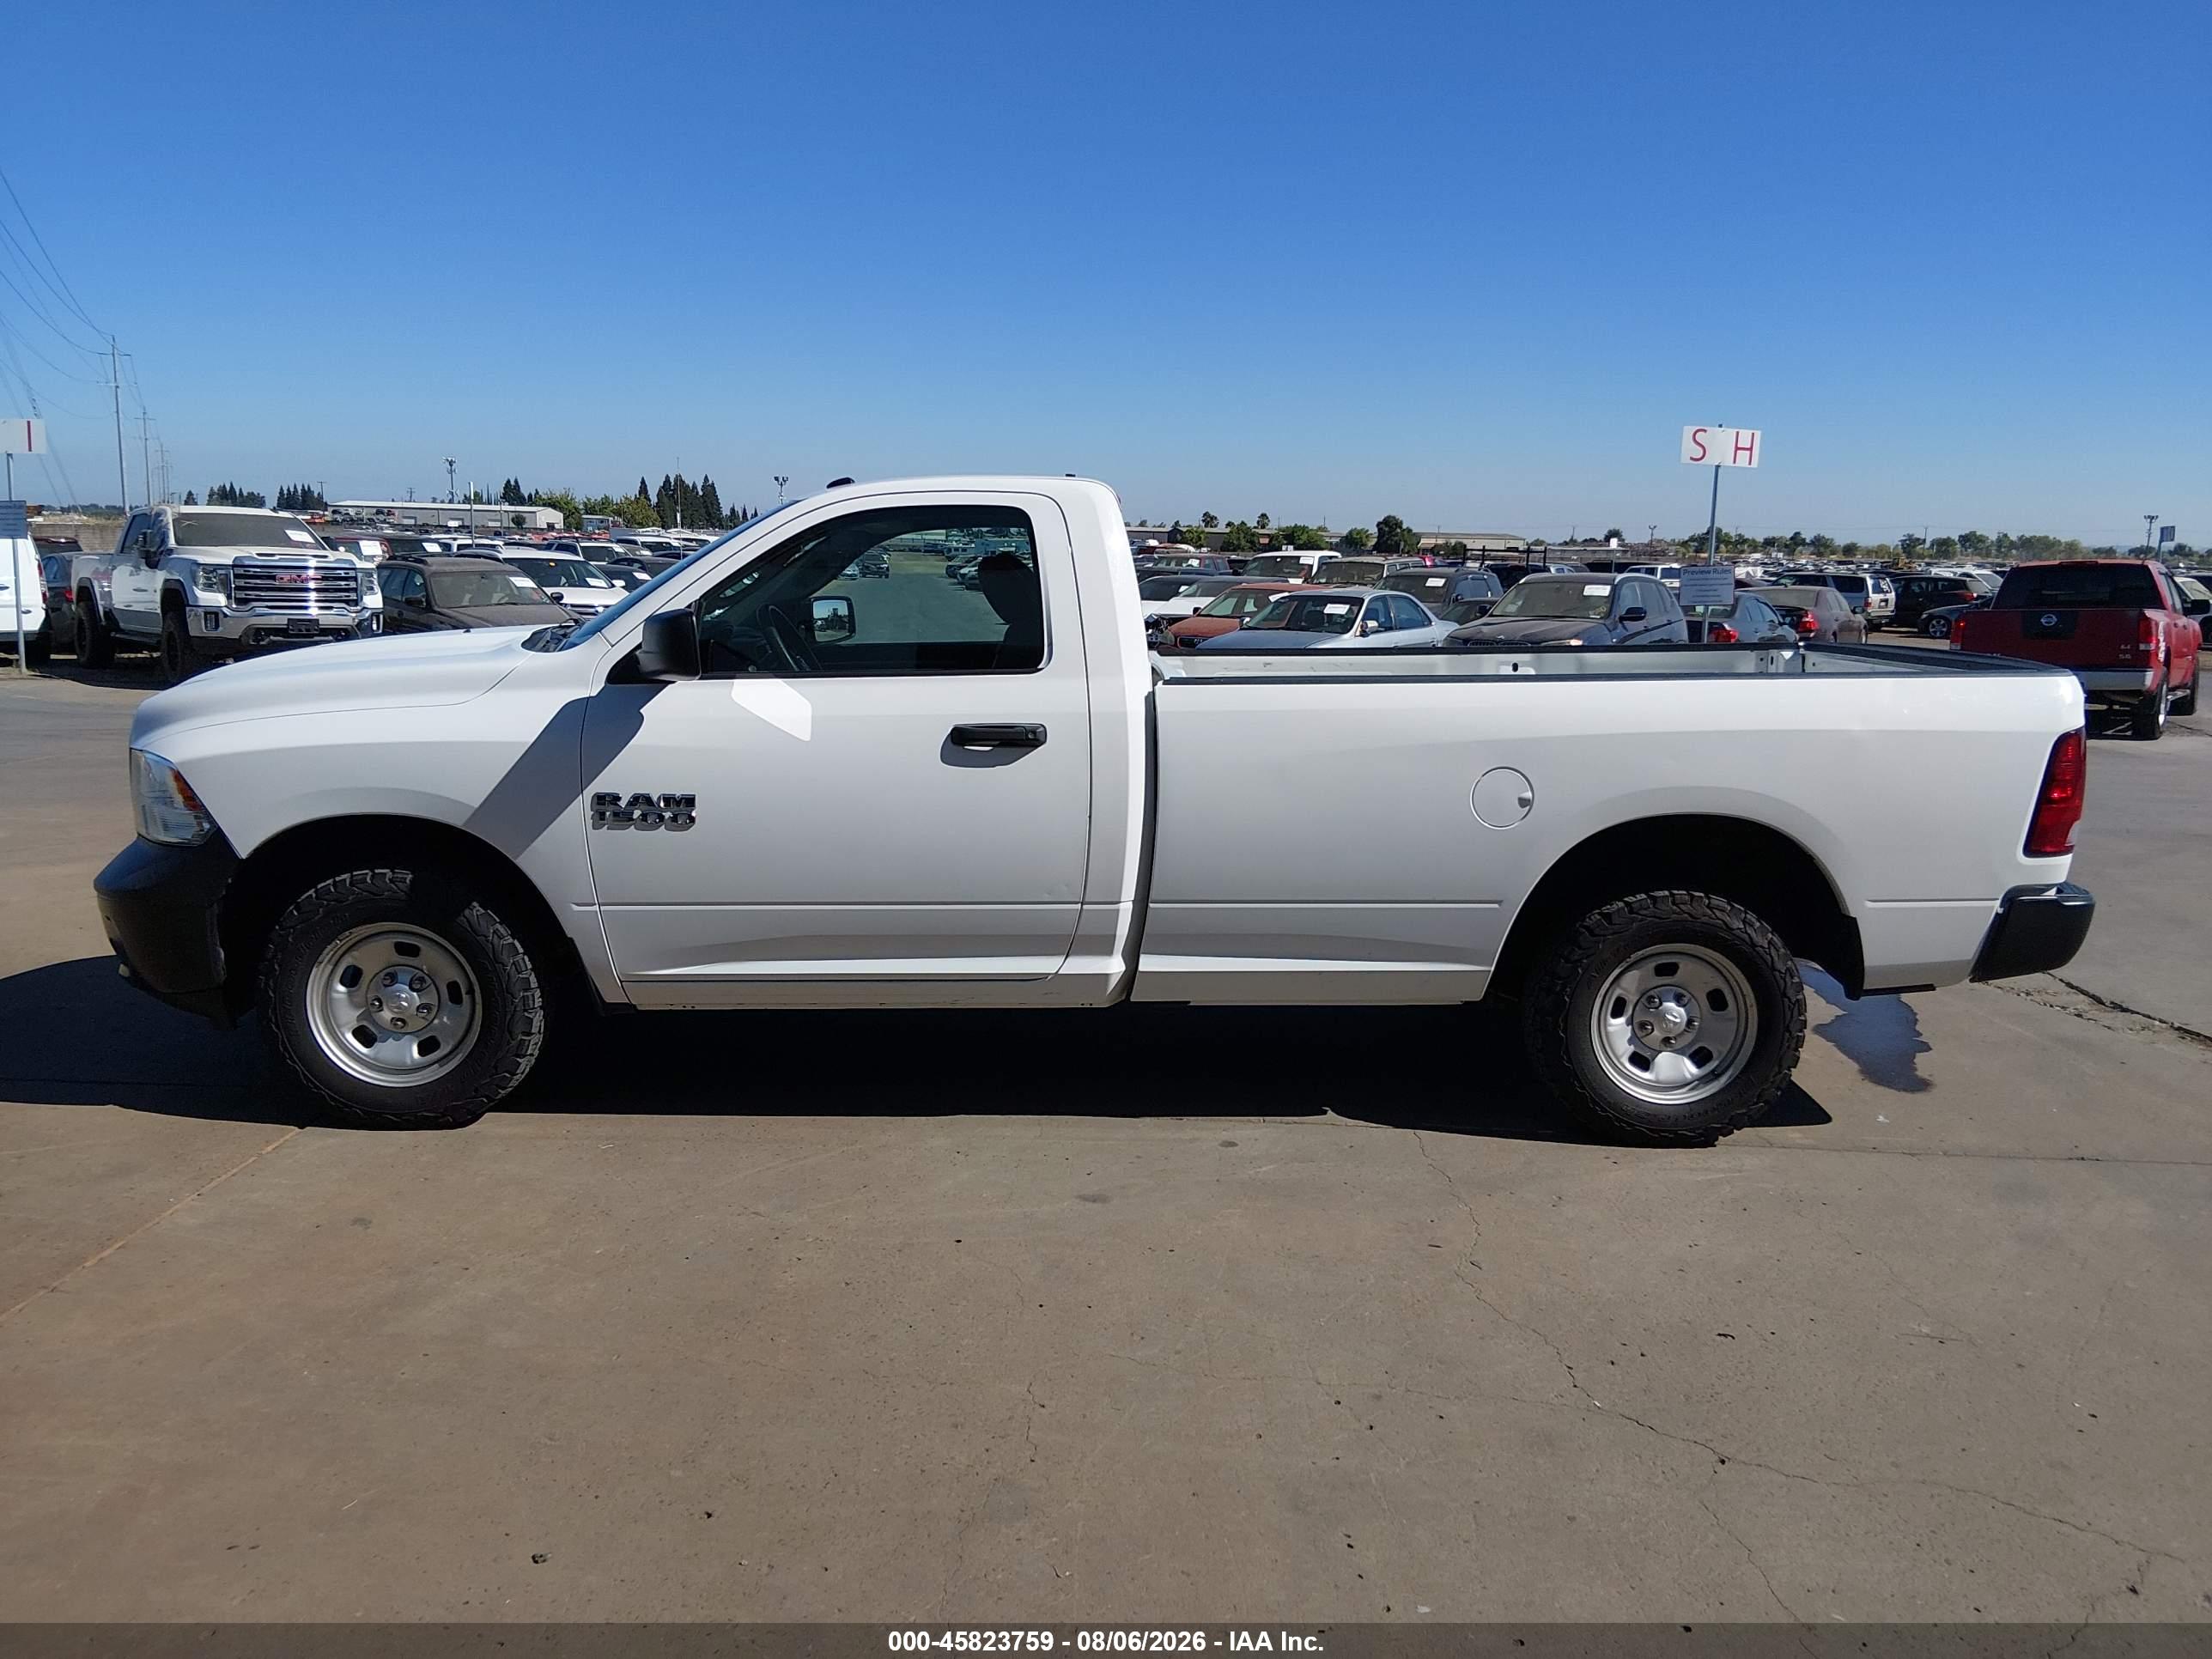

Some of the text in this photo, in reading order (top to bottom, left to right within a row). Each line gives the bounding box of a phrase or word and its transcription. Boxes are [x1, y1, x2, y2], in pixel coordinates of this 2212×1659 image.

[1689, 428, 1755, 465] S H
[276, 574, 323, 584] GMC
[592, 792, 696, 810] RAM
[592, 809, 696, 830] 1500
